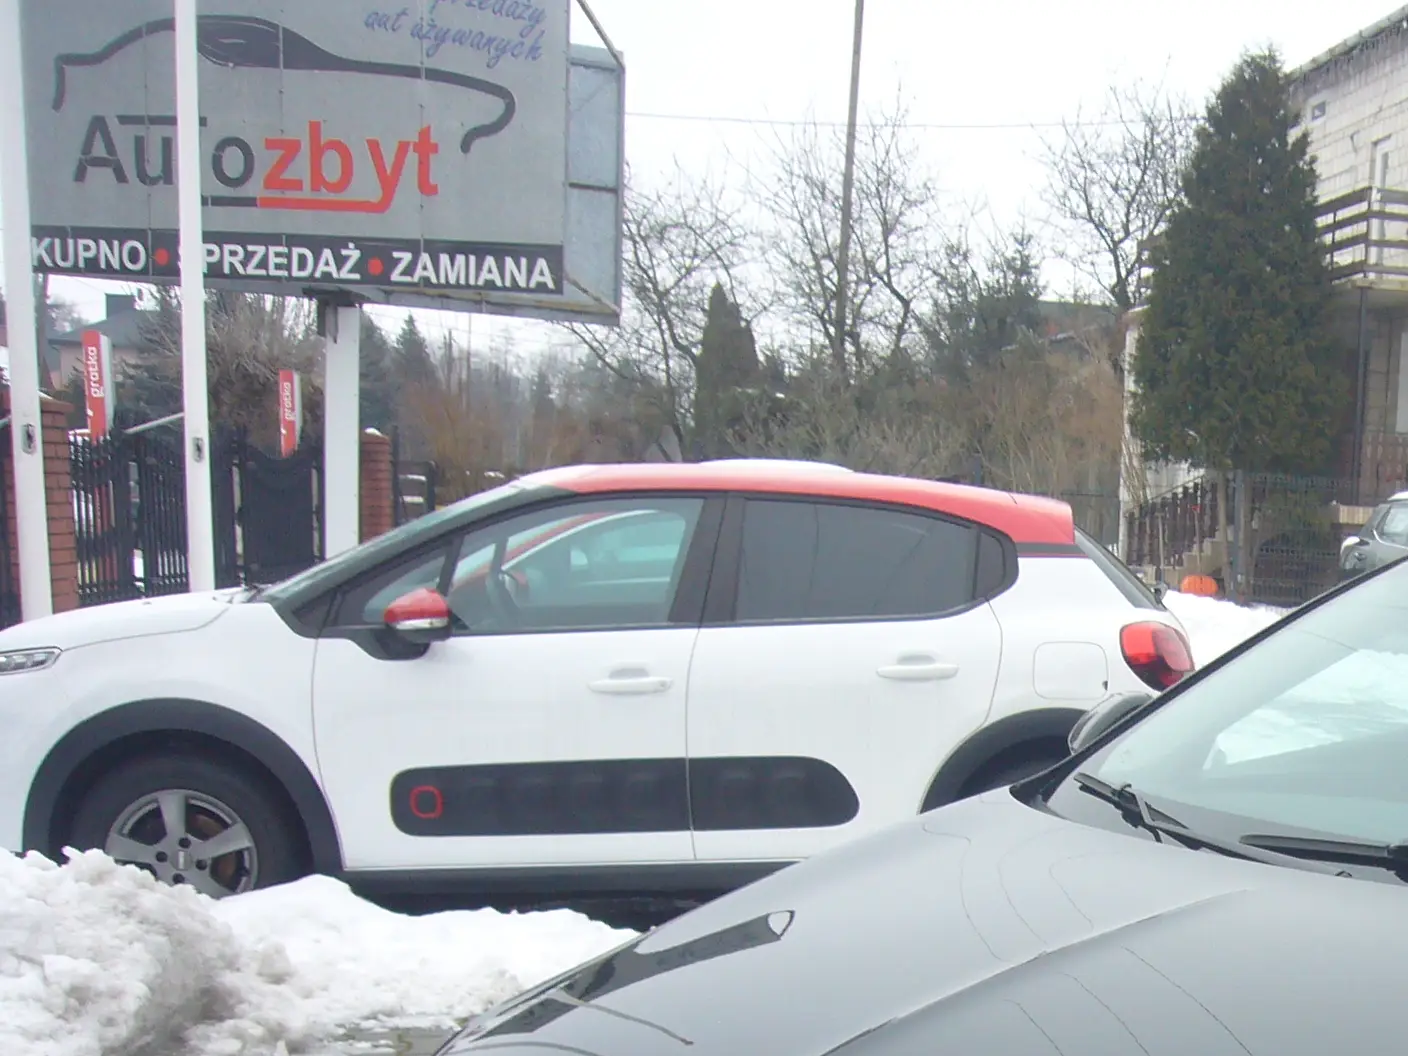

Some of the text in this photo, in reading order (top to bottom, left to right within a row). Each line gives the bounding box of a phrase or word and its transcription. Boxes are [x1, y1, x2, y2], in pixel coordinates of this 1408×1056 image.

[364, 8, 409, 32] aut
[429, 0, 546, 38] zedaży
[31, 237, 555, 289] KUPNO PRZEDAŻ ZAMIANA
[87, 346, 104, 398] gratka
